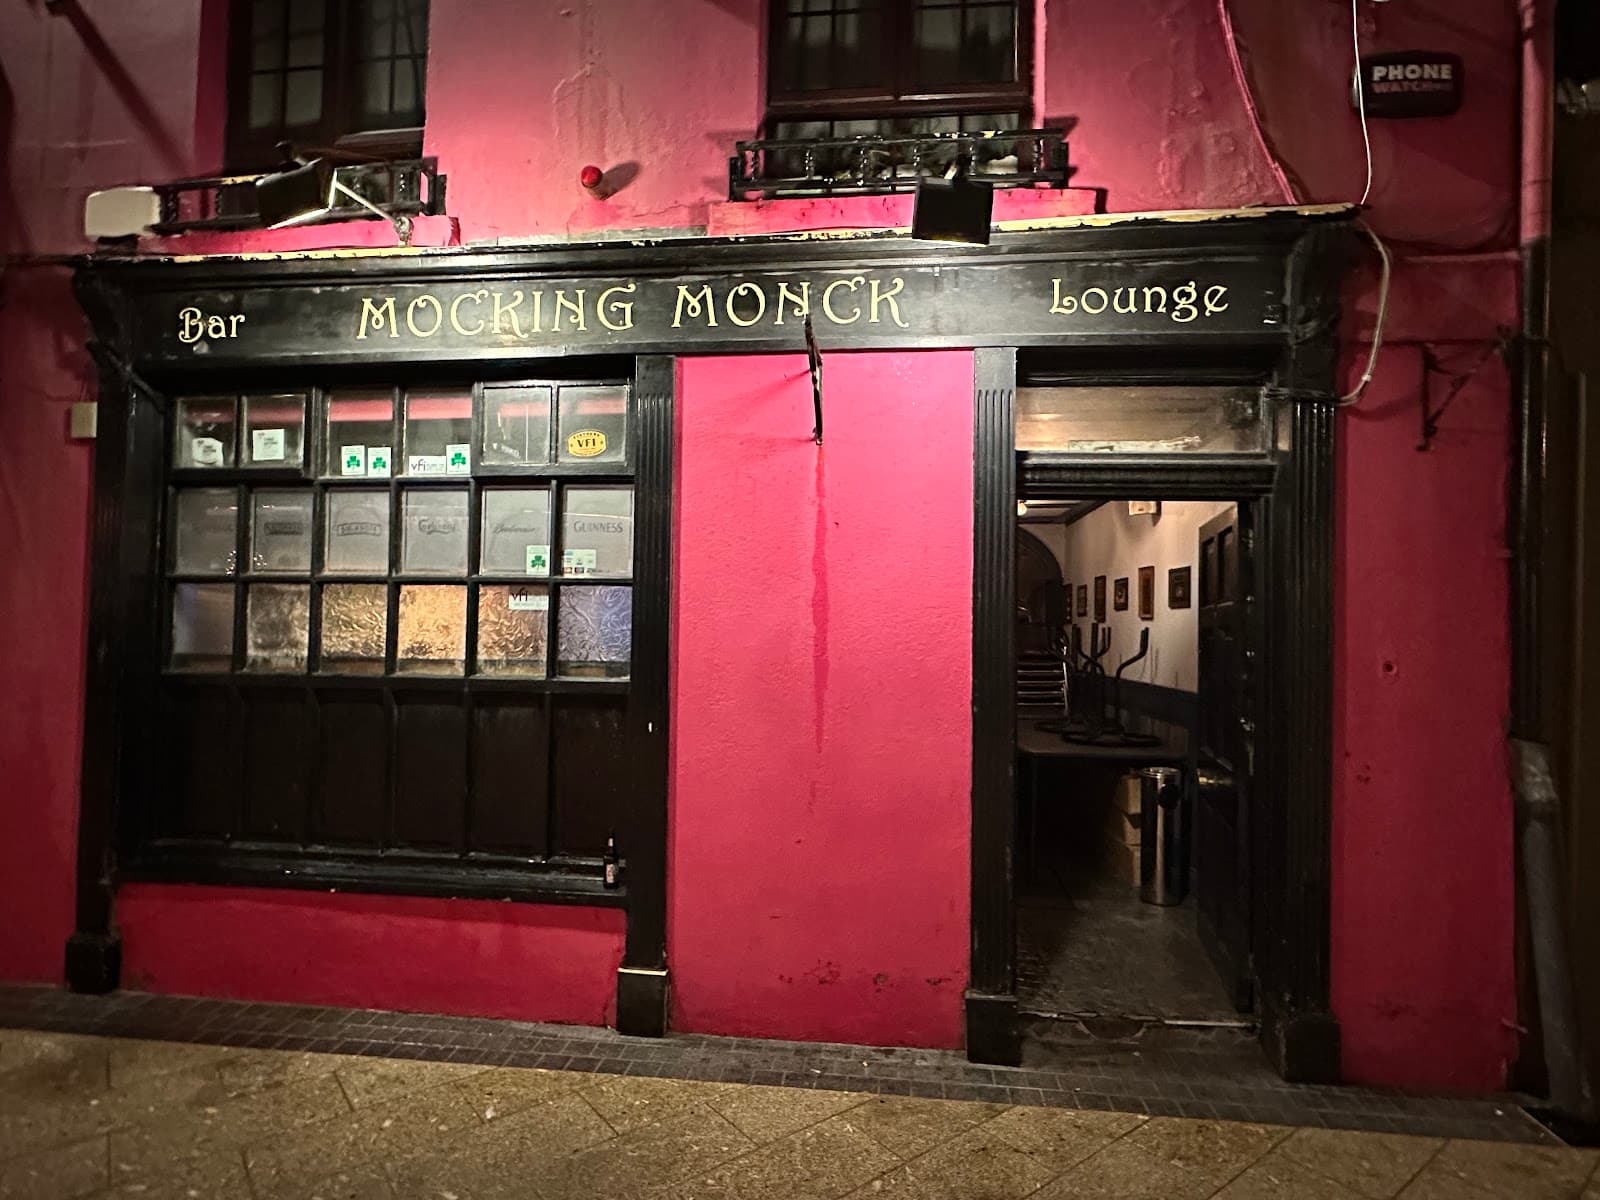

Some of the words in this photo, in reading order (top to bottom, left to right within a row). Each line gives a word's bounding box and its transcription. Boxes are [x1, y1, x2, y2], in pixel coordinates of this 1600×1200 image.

[1372, 63, 1453, 82] PHONE
[355, 282, 638, 340] MOCKING
[671, 275, 911, 329] MONCK
[1049, 277, 1230, 324] Lounge
[178, 307, 246, 343] Bar
[577, 438, 596, 448] VFI
[410, 458, 427, 472] vfi
[573, 520, 624, 533] GUINNESS
